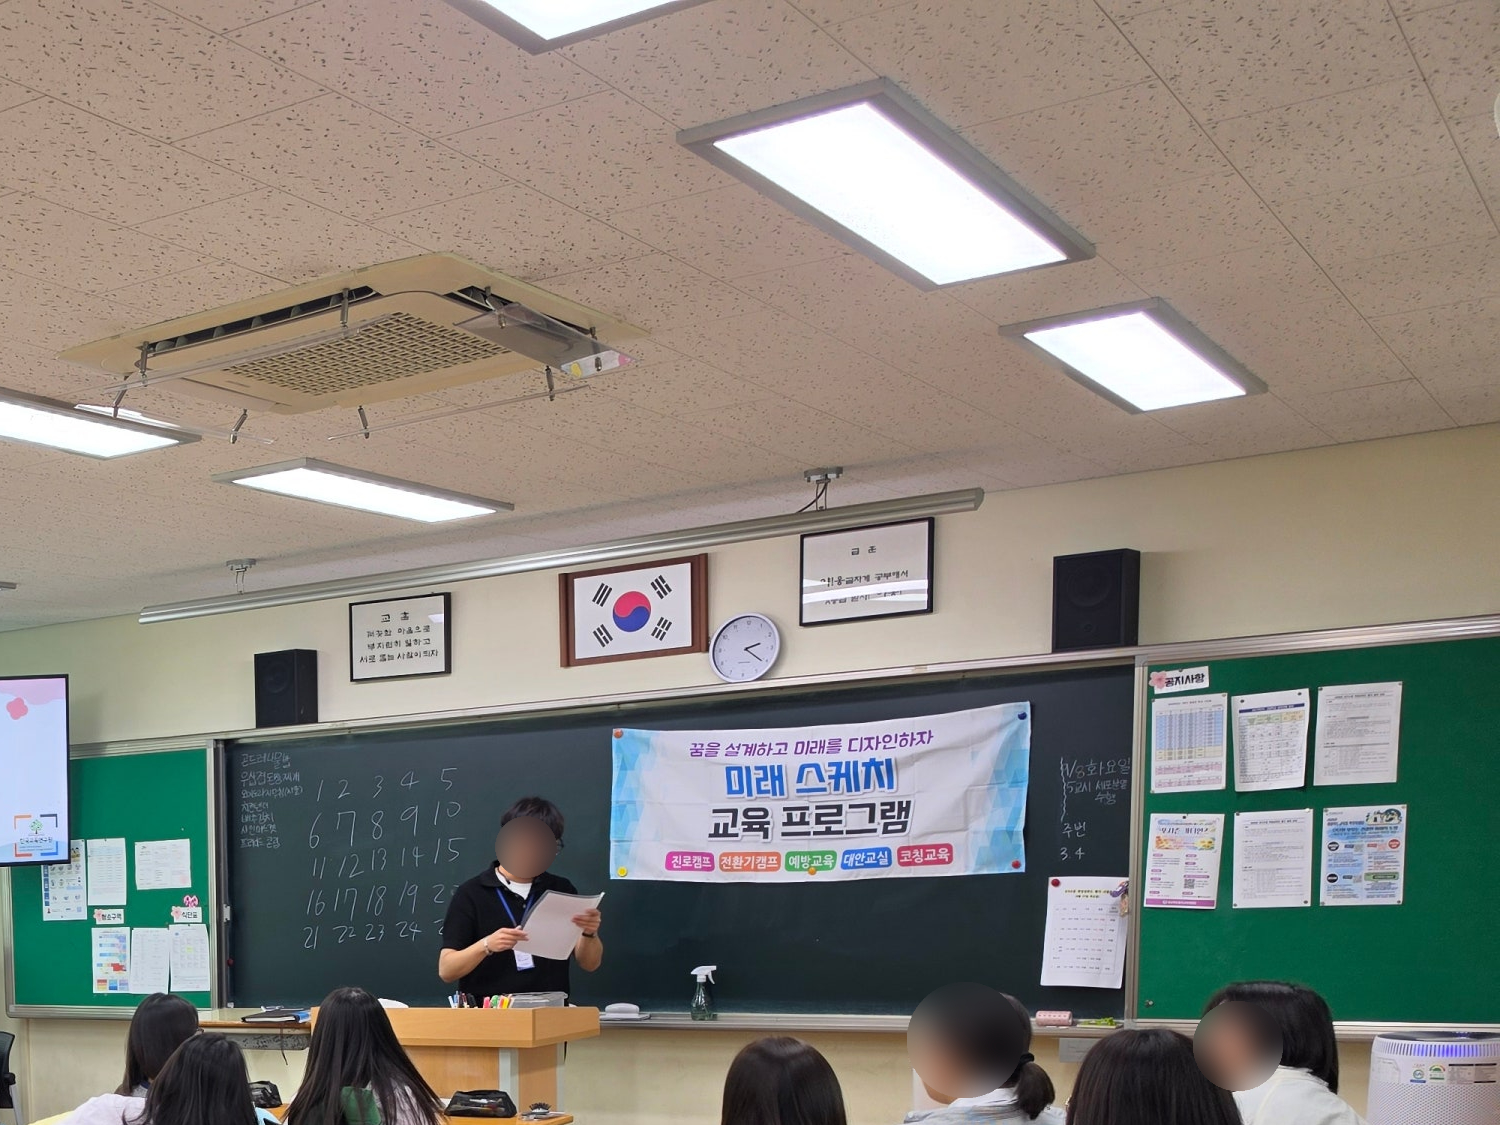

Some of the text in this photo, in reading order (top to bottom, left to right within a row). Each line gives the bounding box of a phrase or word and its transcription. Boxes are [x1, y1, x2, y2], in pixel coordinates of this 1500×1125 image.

[367, 638, 431, 651] 부지런히 일하고
[397, 625, 431, 635] 마음으로
[359, 654, 376, 663] 서로
[1165, 672, 1205, 687] 공지사항
[690, 729, 934, 758] 꿈을 설계하고 미래를 디자인하자
[316, 767, 458, 802] 1 2 3 4 5
[725, 757, 895, 798] 미래 스케치
[309, 812, 322, 849] 6
[336, 810, 356, 847] 7
[371, 810, 383, 840] 8
[400, 805, 419, 836] 9
[434, 801, 461, 825] 10
[708, 798, 913, 841] 교육 프로그램
[1062, 821, 1086, 839] 주번
[312, 837, 466, 879] 11 12 13 14 15
[671, 847, 950, 870] 진로캠프 전환기캠프 예방교육 대안교실 코칭교육
[181, 911, 198, 919] 식단표
[306, 889, 325, 916] 16
[333, 887, 357, 921] 17
[366, 885, 387, 916] 18
[398, 880, 419, 914] 19
[303, 925, 319, 949] 21
[333, 925, 356, 943] 22
[365, 923, 384, 942] 23
[395, 920, 422, 941] 24
